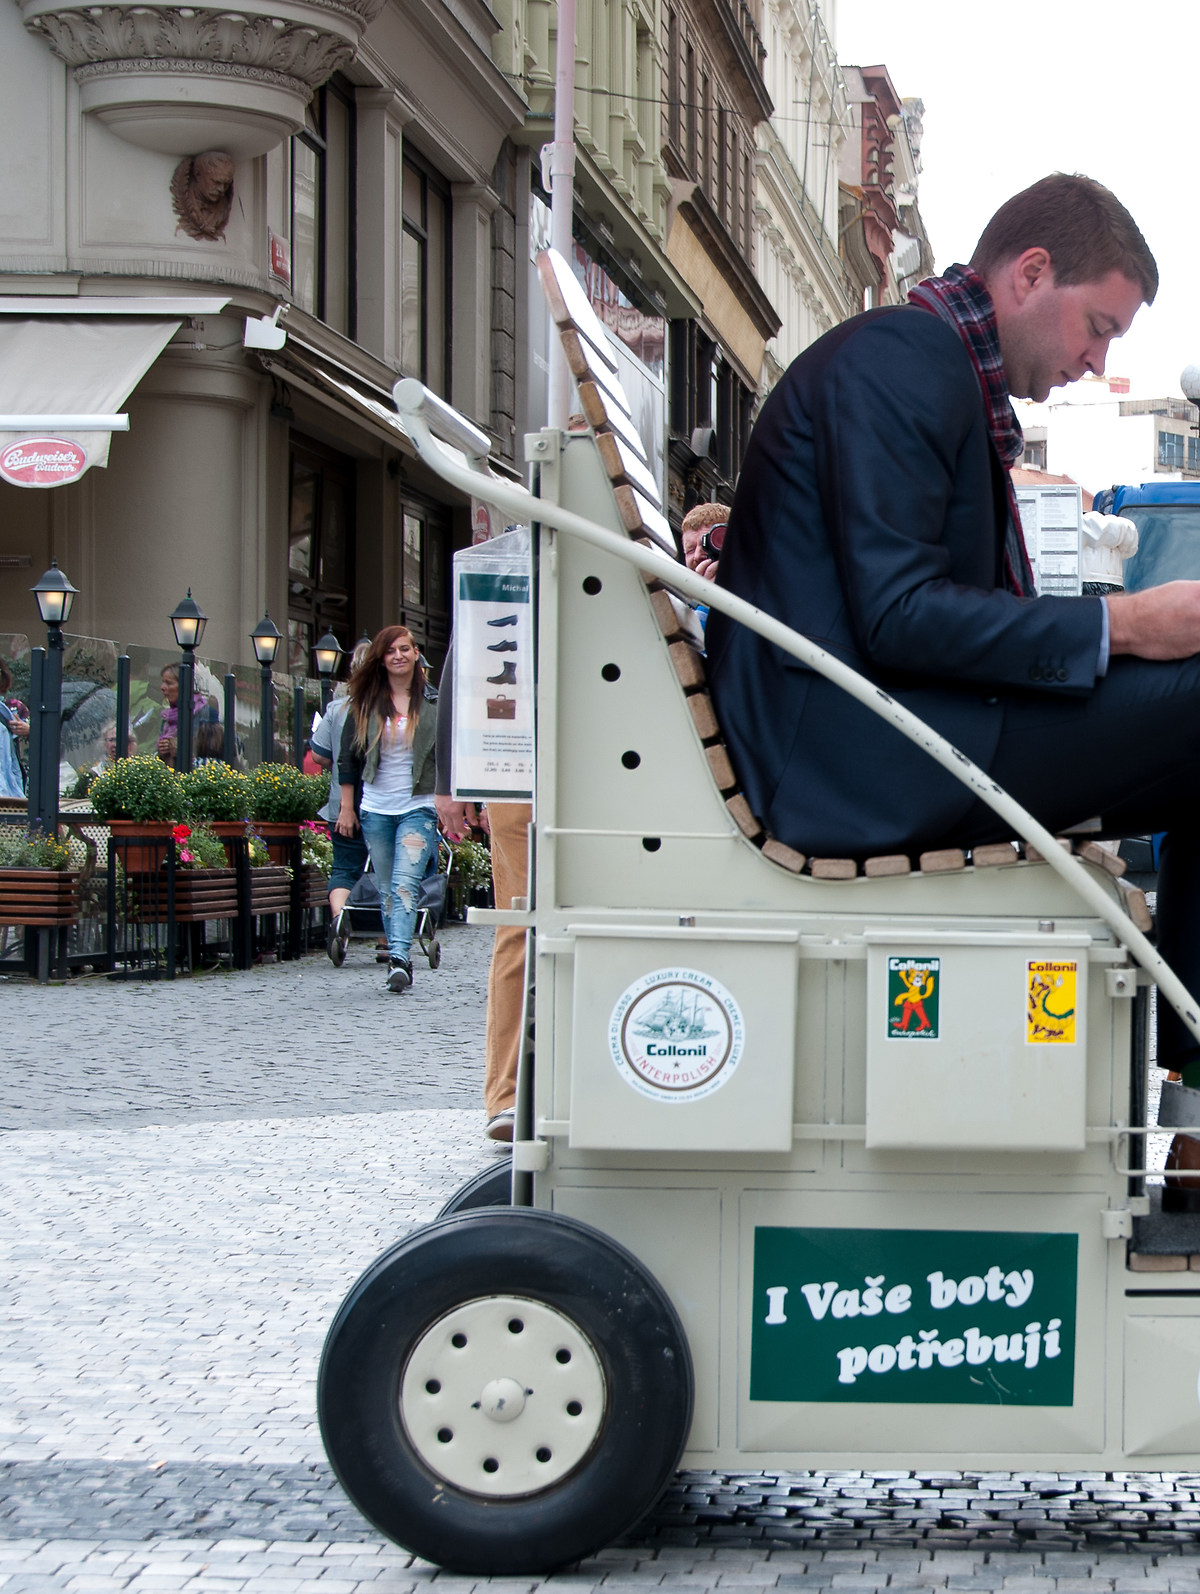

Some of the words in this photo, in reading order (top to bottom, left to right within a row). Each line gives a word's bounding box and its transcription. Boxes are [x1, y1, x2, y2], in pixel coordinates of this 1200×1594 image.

[4, 449, 78, 468] Budweiser
[502, 584, 529, 592] Michal
[889, 958, 940, 971] Collonil
[1027, 961, 1077, 971] Collonil
[644, 971, 680, 986] LUXURY
[682, 971, 713, 988] CREAM
[616, 993, 632, 1021] LUSSO
[724, 998, 741, 1026] CREME
[610, 1035, 624, 1066] CREMA
[646, 1044, 707, 1056] Collonil
[729, 1043, 742, 1066] LUXE
[635, 1055, 717, 1084] INTERPOLISH
[765, 1286, 789, 1325] I
[801, 1274, 912, 1321] Vaše
[926, 1265, 1034, 1309] boty
[836, 1318, 1062, 1384] potřebují
